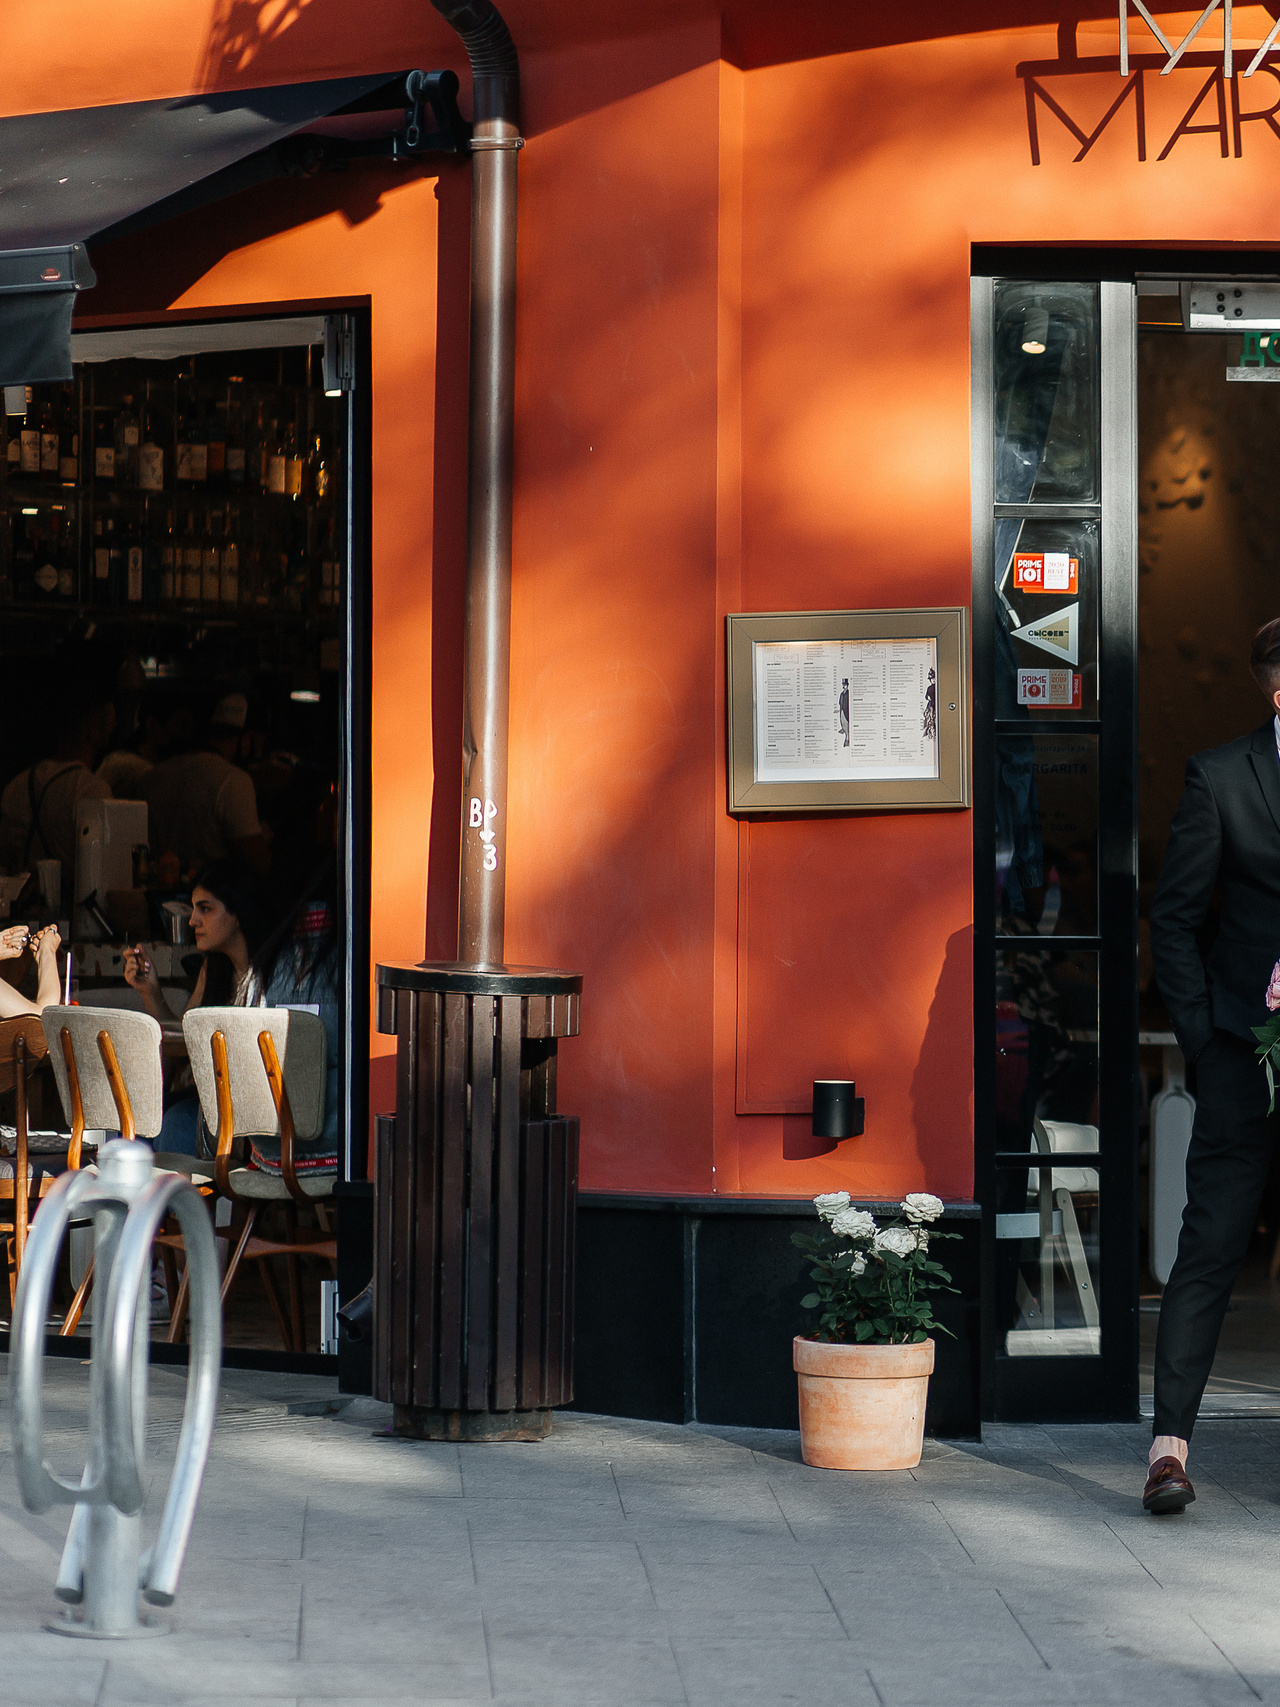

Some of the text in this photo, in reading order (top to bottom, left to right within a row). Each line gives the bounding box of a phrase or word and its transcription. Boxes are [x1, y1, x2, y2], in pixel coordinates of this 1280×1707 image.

[1017, 560, 1042, 568] PRIME
[1018, 568, 1042, 582] 101
[1021, 675, 1047, 684] PRIME
[1022, 684, 1047, 698] 101
[482, 843, 498, 871] 3
